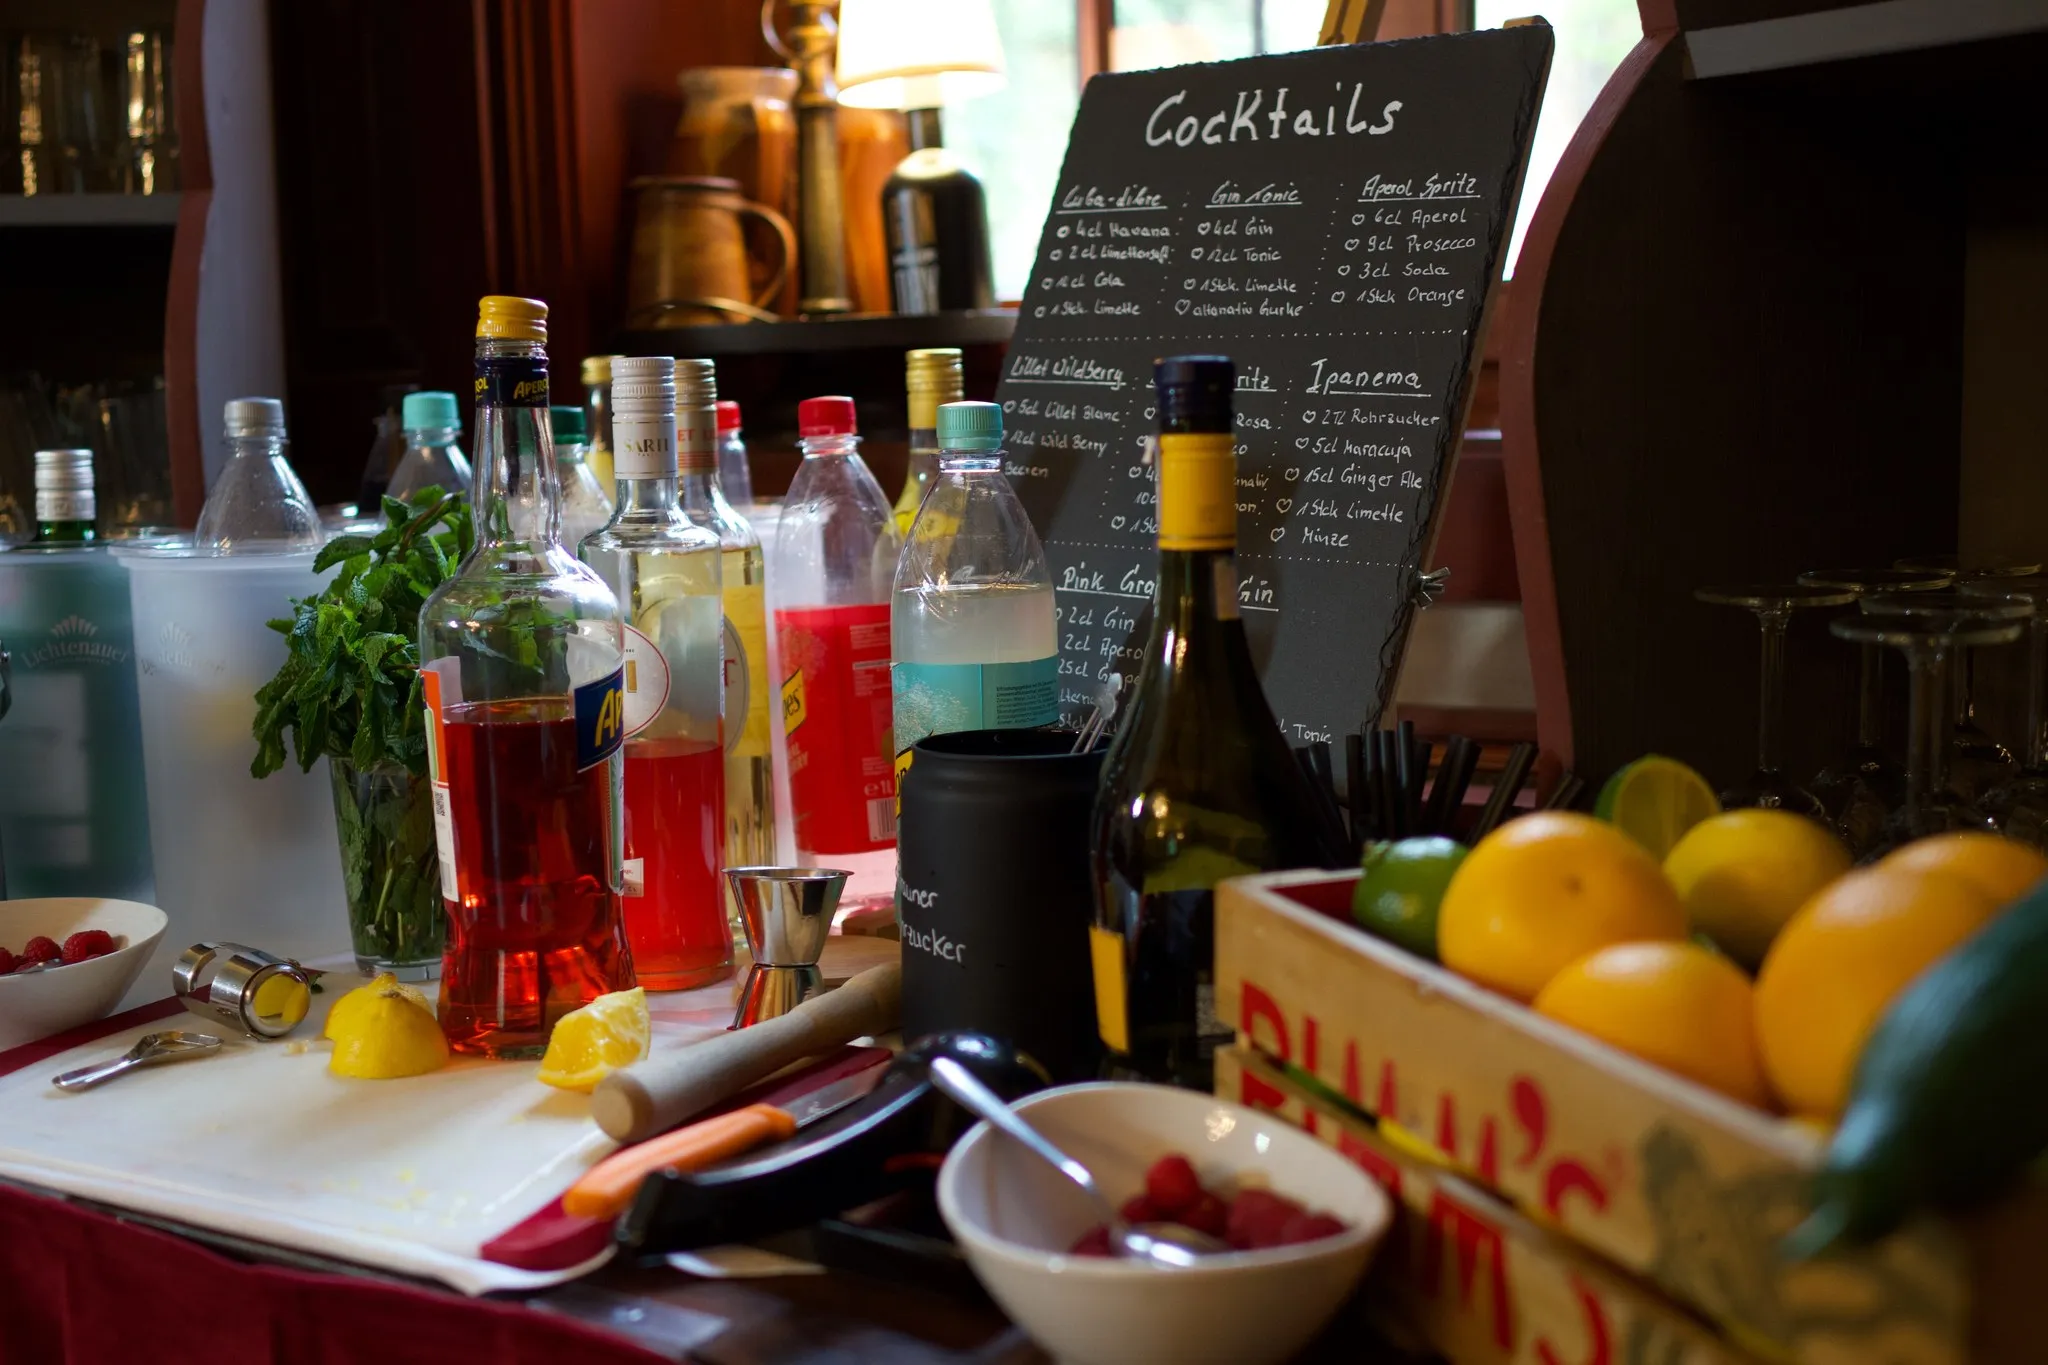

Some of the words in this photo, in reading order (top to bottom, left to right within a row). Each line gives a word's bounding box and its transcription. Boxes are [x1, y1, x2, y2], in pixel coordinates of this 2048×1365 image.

[1211, 180, 1240, 204] Gin
[1244, 181, 1299, 204] Tonic
[1361, 174, 1413, 202] Aperol
[1419, 172, 1477, 199] Spritz
[1245, 216, 1273, 236] Gin
[1411, 208, 1467, 229] Aperol
[1109, 222, 1170, 238] Havana
[1243, 246, 1282, 262] Tonic
[1405, 234, 1476, 254] Prosecco
[1094, 270, 1125, 288] Cola
[1401, 262, 1450, 277] Soda
[1245, 277, 1297, 293] Limette
[1094, 298, 1141, 316] Limette
[1259, 297, 1303, 317] Gurke
[1407, 286, 1466, 307] Orange
[1010, 355, 1049, 377] Lillet
[1306, 357, 1423, 396] Ipanema
[1018, 398, 1040, 415] 5cl
[1044, 401, 1077, 420] Lillet
[1083, 404, 1121, 422] Blanc
[1351, 408, 1441, 427] Rohrzucker
[1235, 412, 1273, 430] Rosa
[1040, 430, 1069, 449] Wild
[1072, 434, 1109, 458] Berry
[1312, 437, 1339, 454] 5cl
[1343, 437, 1413, 464] Maracuja
[1304, 467, 1334, 484] 15cl
[1341, 463, 1394, 492] Ginger
[1400, 470, 1423, 489] Ale
[1346, 500, 1404, 523] Limette
[1302, 526, 1350, 547] Minze
[1063, 561, 1106, 592] Pink
[1068, 606, 1093, 626] 2cl
[1103, 606, 1136, 633] Gin
[1064, 633, 1091, 652] 2cl
[1293, 723, 1333, 744] Tonic
